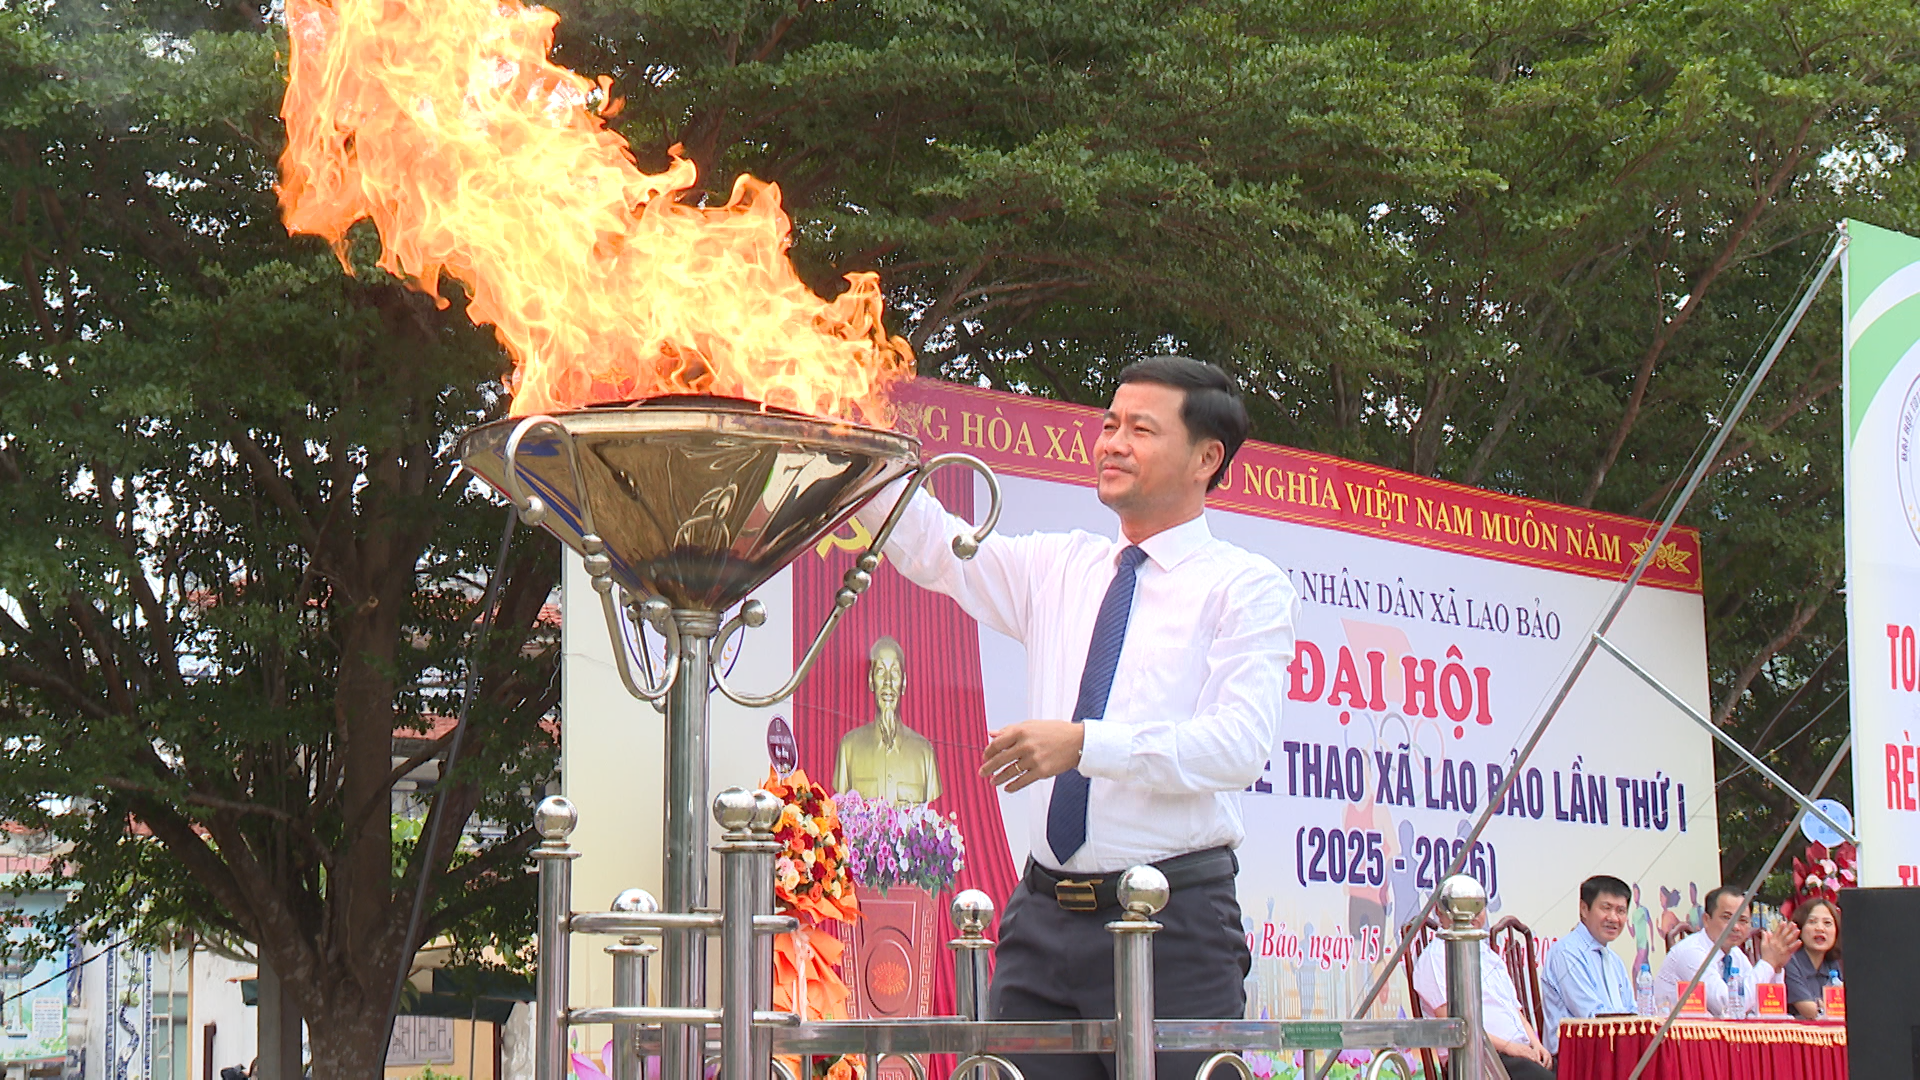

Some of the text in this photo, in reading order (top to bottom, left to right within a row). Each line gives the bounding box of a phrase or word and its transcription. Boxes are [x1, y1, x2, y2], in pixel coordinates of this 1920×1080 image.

[960, 406, 1037, 457] HÒA
[1043, 420, 1091, 465] XÃ
[1243, 462, 1341, 510] NGHĨA
[1344, 479, 1409, 528] VIỆT
[1415, 497, 1474, 538] NAM
[1480, 509, 1558, 552] MUÔN
[1565, 522, 1623, 565] NĂM
[1301, 567, 1370, 610] NHÂN
[1376, 577, 1424, 619] DÂN
[1466, 599, 1509, 633] LAO
[1516, 597, 1560, 640] BẢO
[1286, 640, 1493, 740] ĐẠI HỘI
[1886, 624, 1920, 692] TO
[1283, 740, 1364, 802] THAO
[1374, 742, 1416, 807] XÃ
[1424, 756, 1477, 814] LAO
[1487, 748, 1544, 820] BẢO
[1553, 755, 1609, 826] LẦN
[1615, 771, 1670, 831] THỨ
[1677, 783, 1687, 832] I
[1296, 826, 1384, 887] (2025
[1394, 859, 1405, 870] -
[1261, 922, 1303, 965] Bảo,
[1309, 925, 1354, 970] ngày
[1360, 924, 1379, 962] 15
